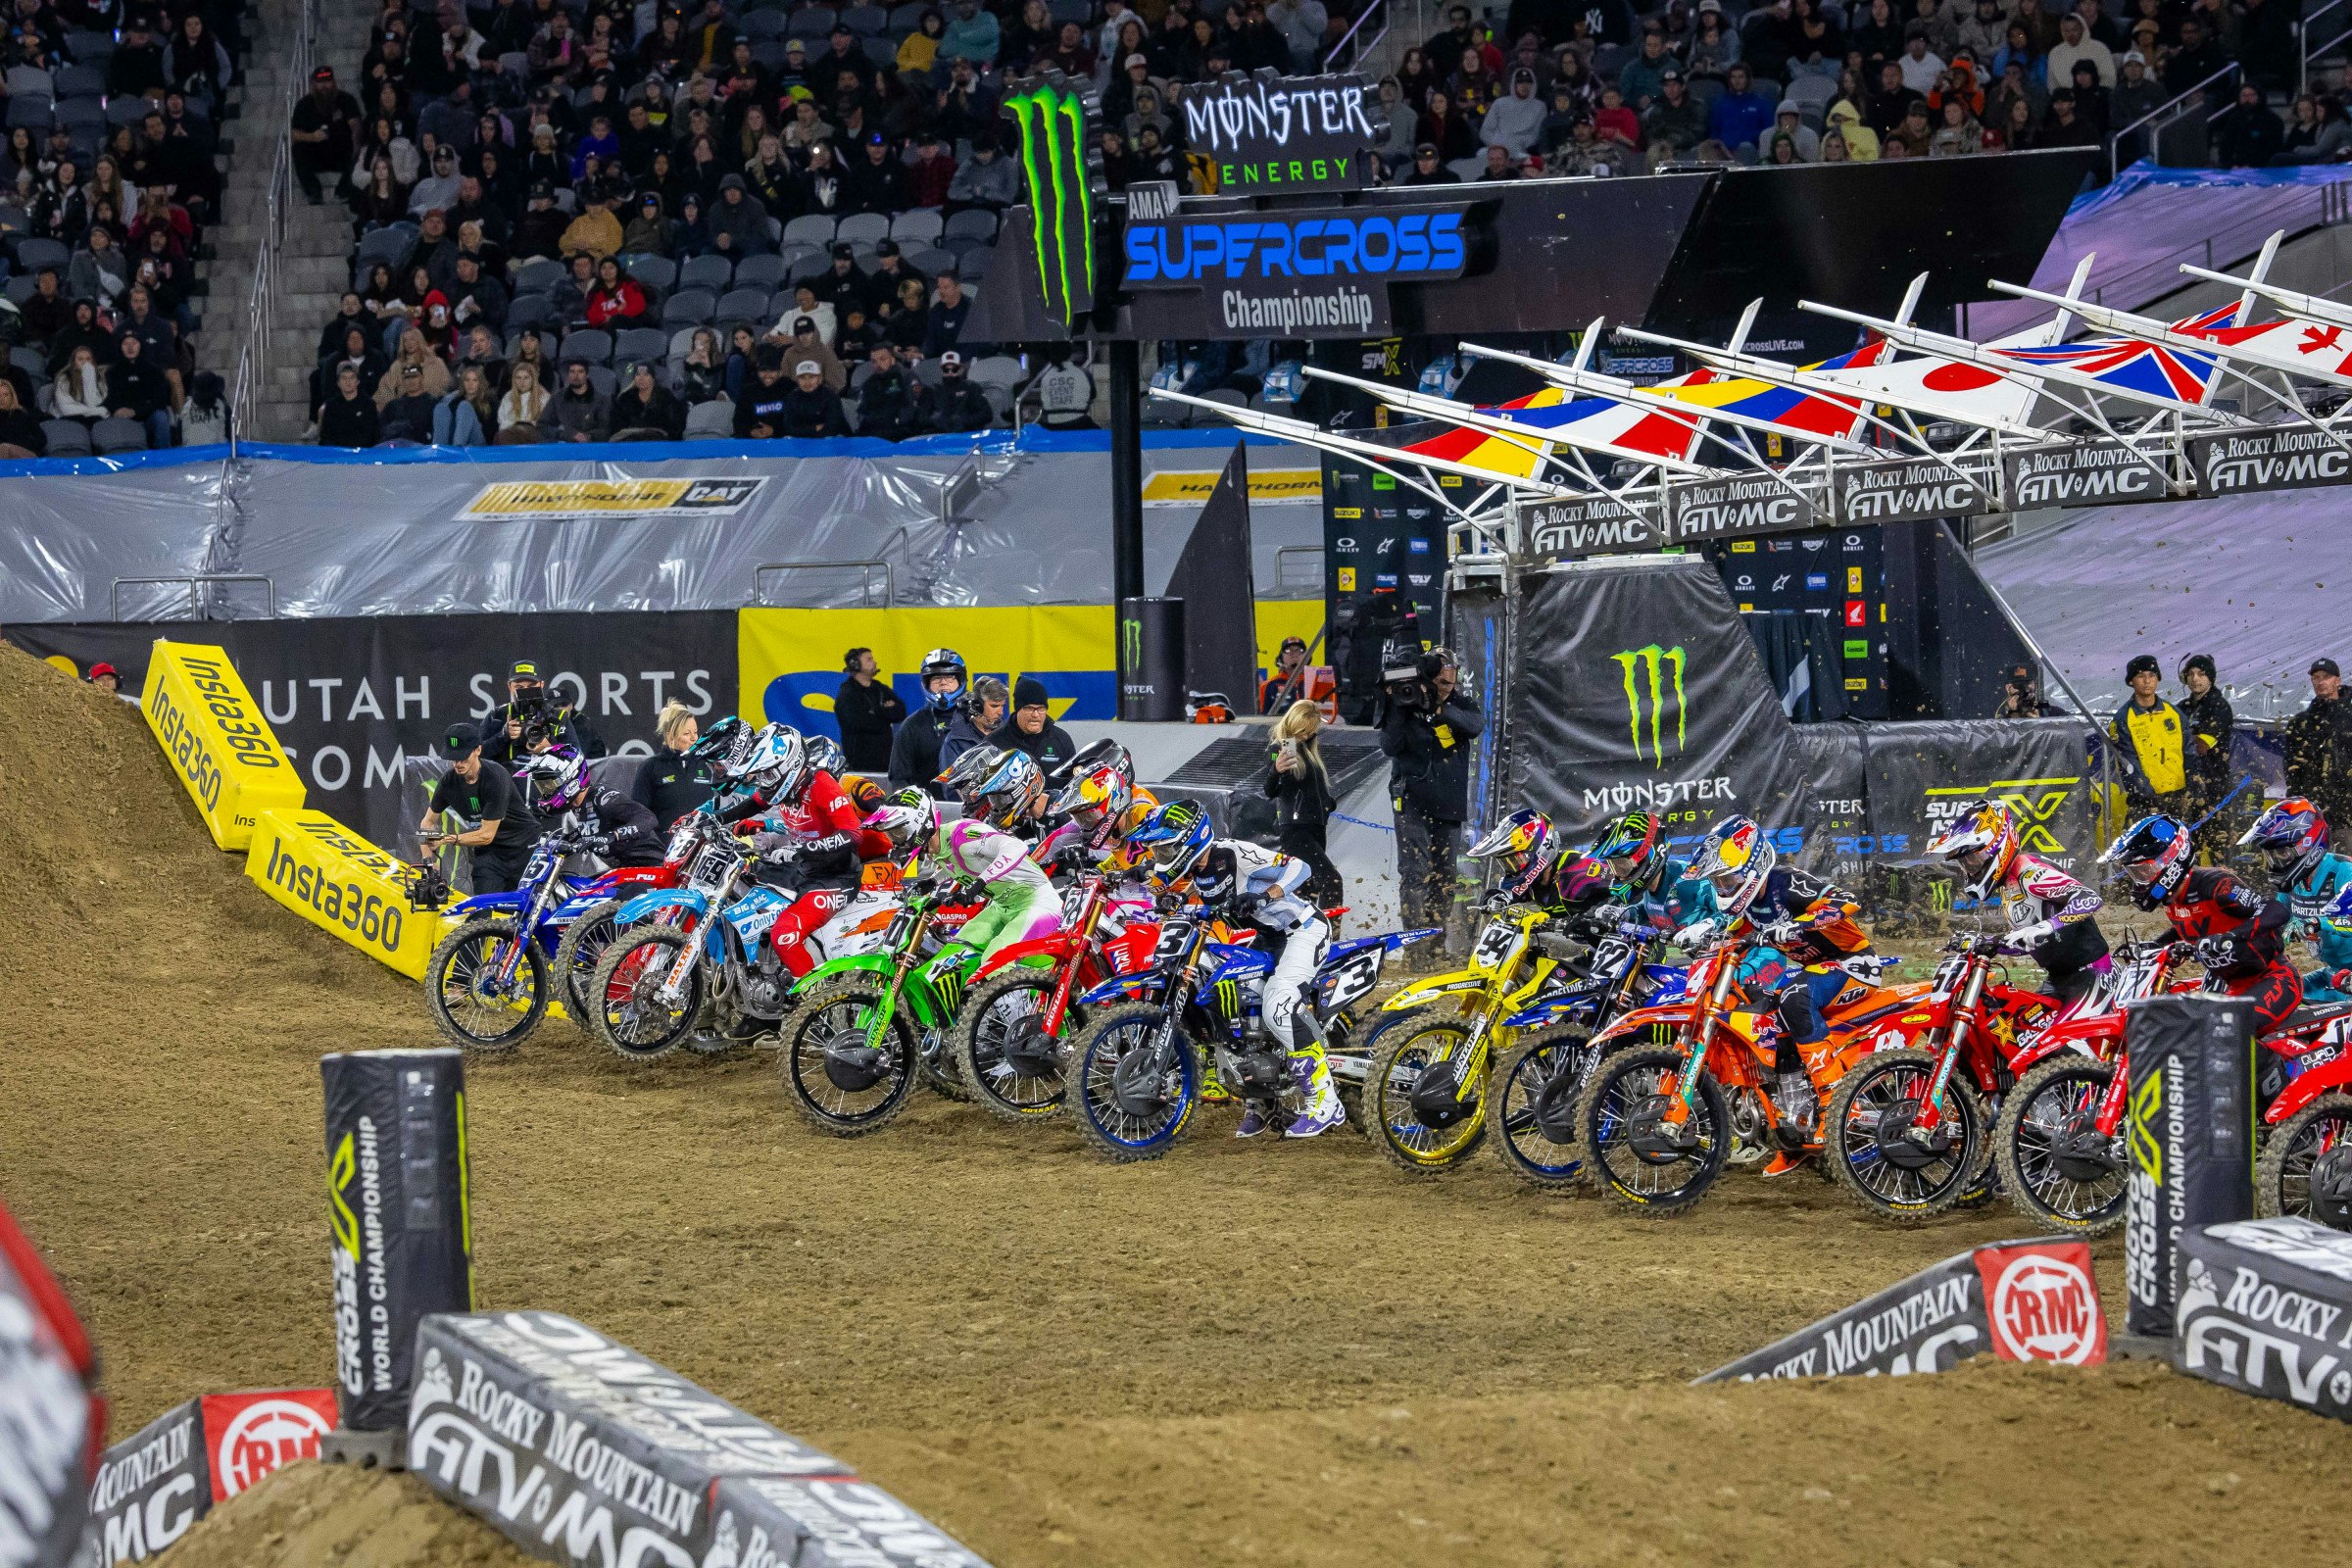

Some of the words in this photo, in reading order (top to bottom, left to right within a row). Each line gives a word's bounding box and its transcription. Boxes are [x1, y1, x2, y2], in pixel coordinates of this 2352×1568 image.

[1185, 82, 1373, 151] MONSTER
[1222, 158, 1349, 185] ENERGY
[1128, 191, 1165, 220] AMA
[1126, 213, 1465, 280] SUPERCROSS
[1222, 287, 1373, 333] Championship
[2034, 453, 2073, 471] ROCKY
[2228, 438, 2272, 458] ROCKY
[1693, 486, 1726, 506] ROCKY
[1863, 469, 1903, 489] ROCKY
[1547, 506, 1584, 524] ROCKY
[180, 657, 279, 768] Insta360
[263, 674, 429, 724] UTAH
[469, 669, 712, 720] SORTS
[151, 674, 221, 812] Insta360
[1583, 776, 1736, 812] MONSTER
[914, 806, 927, 824] FOX
[807, 833, 851, 852] ONEAL
[267, 836, 403, 953] Insta360
[734, 903, 750, 915] BIG
[754, 893, 768, 906] MAC
[754, 907, 787, 930] OnlyFa
[1396, 928, 1432, 939] DUNLOP
[1156, 922, 1192, 956] 3
[1477, 928, 1515, 961] 94
[504, 948, 521, 981] DUNLOP
[667, 942, 694, 988] MAXXIS
[1343, 956, 1377, 995] 3
[1590, 940, 1629, 979] 32
[1687, 960, 1711, 995] 4
[1446, 980, 1482, 991] PROGRESSIVE
[1837, 987, 1867, 1004] KTM
[2263, 981, 2283, 1009] FLY
[1046, 983, 1065, 1028] DUNLOP
[2314, 1005, 2342, 1016] HONDA
[1154, 1016, 1171, 1060] DUNLOP
[1452, 1033, 1478, 1078] DUNLOP
[2301, 1046, 2336, 1065] QUAD
[1686, 1052, 1705, 1086] MOTOREX
[1936, 1051, 1956, 1090] MOTOREX
[2169, 1054, 2186, 1221] CHAMPIONSHIP
[360, 1116, 387, 1300] CHAMPIONSHIP
[2139, 1173, 2157, 1307] CROSS
[2223, 1266, 2342, 1342] ROCKY
[1824, 1274, 1973, 1378] MOUNTAIN
[369, 1305, 392, 1392] WORLD
[2185, 1315, 2340, 1404] ATV
[458, 1358, 544, 1450] ROCKY
[546, 1409, 703, 1537] MOUNTAIN
